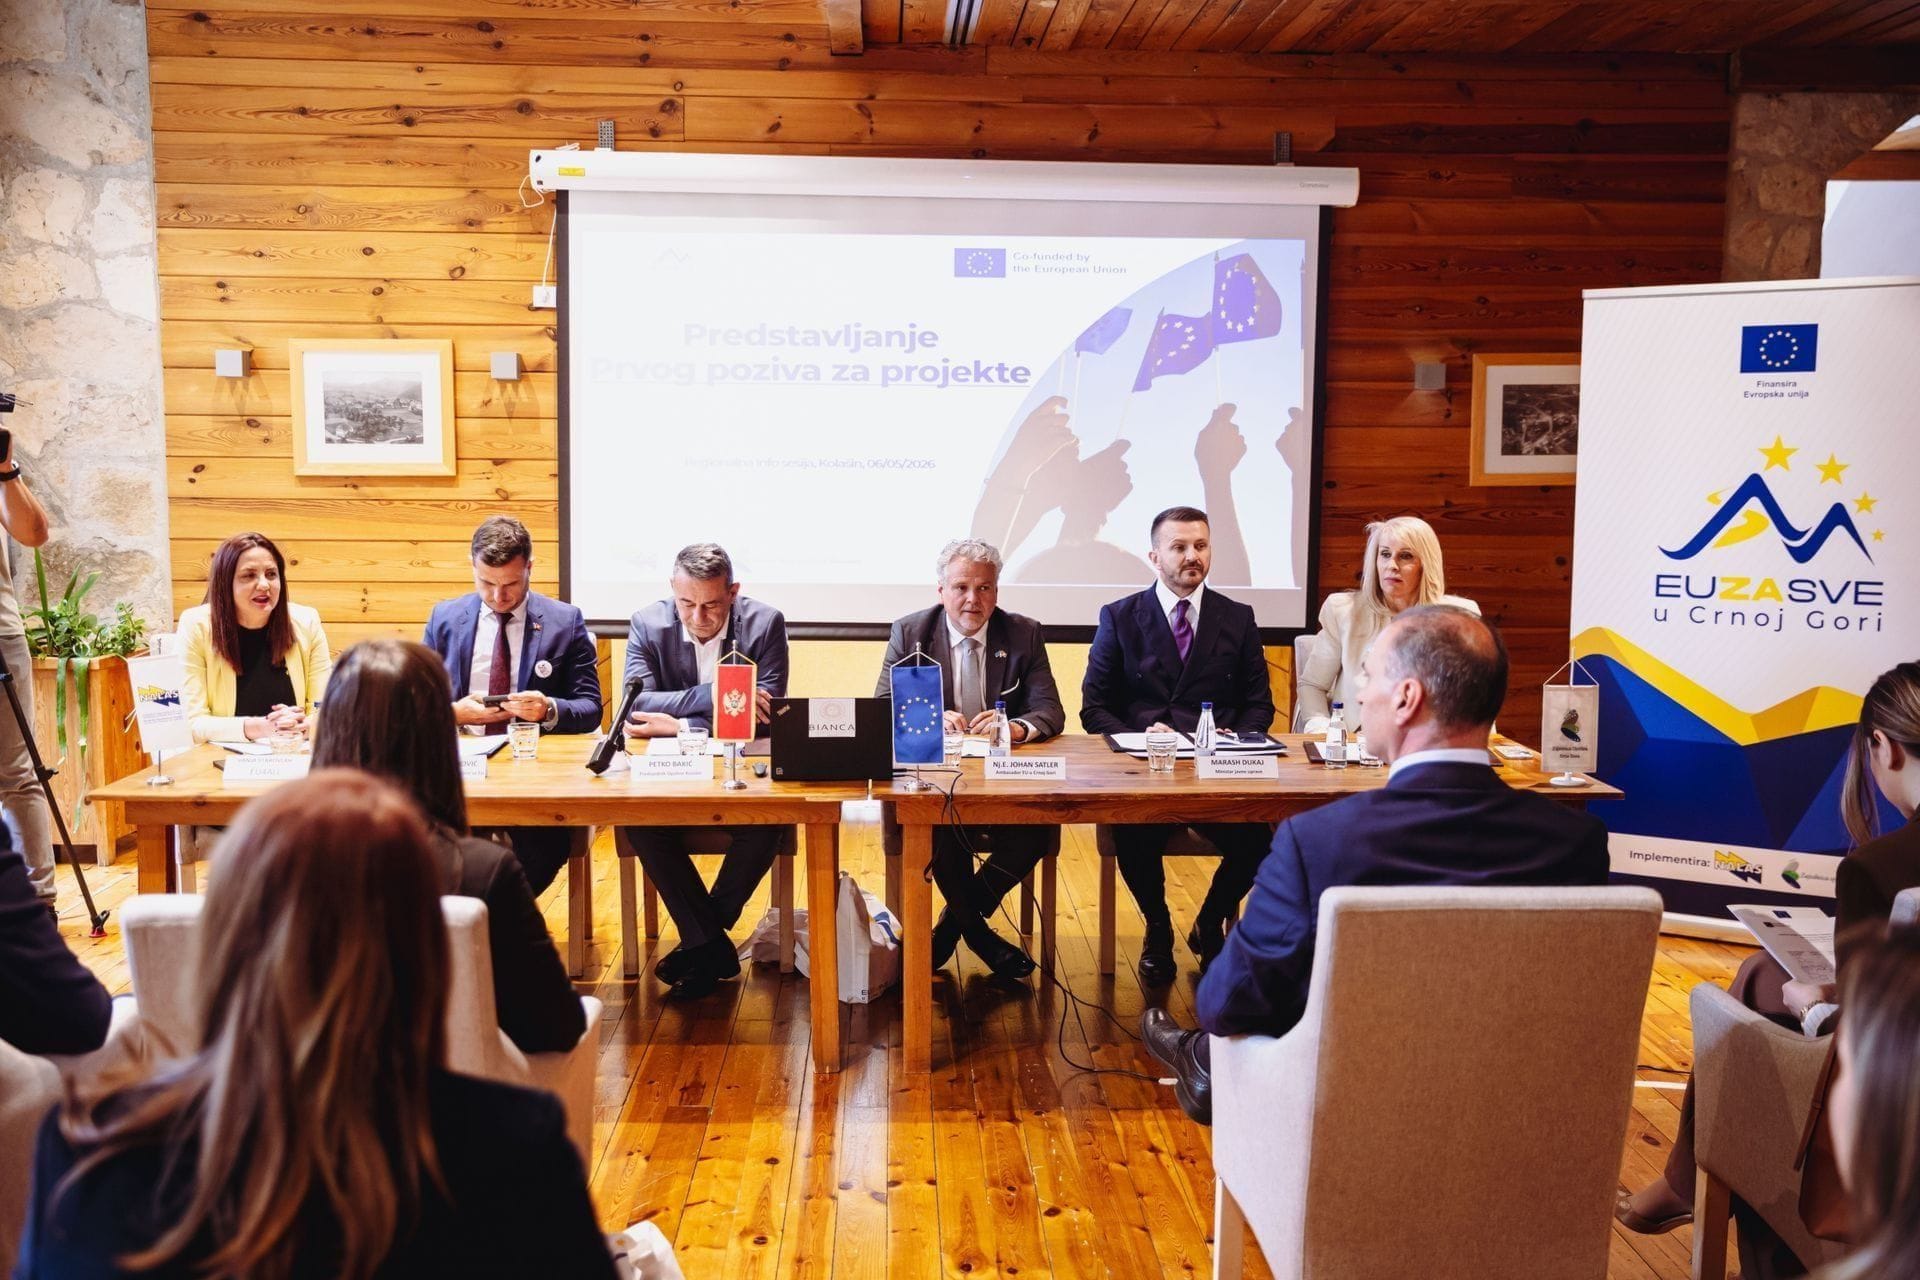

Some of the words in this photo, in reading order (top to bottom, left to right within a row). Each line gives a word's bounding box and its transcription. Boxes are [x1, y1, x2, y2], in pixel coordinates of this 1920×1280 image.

[1012, 251, 1073, 262] Co-funded
[1076, 251, 1091, 264] by
[1012, 264, 1032, 274] the
[1034, 264, 1090, 275] European
[1093, 265, 1128, 275] Union
[683, 322, 940, 354] Predstavljanje
[589, 356, 696, 387] Prvog
[706, 355, 822, 387] poziva
[831, 363, 871, 382] za
[880, 357, 1032, 389] projekte
[1756, 379, 1798, 389] Finansira
[1743, 391, 1785, 400] Evropska
[1787, 389, 1810, 400] unija
[867, 458, 937, 470] 06/05/2026
[1653, 606, 1669, 623] u
[1688, 605, 1785, 633] Crnoj
[1805, 609, 1884, 633] Gori
[808, 723, 856, 732] BIANCA
[648, 760, 671, 768] PETKO
[1010, 761, 1034, 769] JOHAN
[1034, 761, 1059, 769] SATLER
[1629, 850, 1711, 868] Implementira:
[1713, 860, 1763, 875] NALAS
